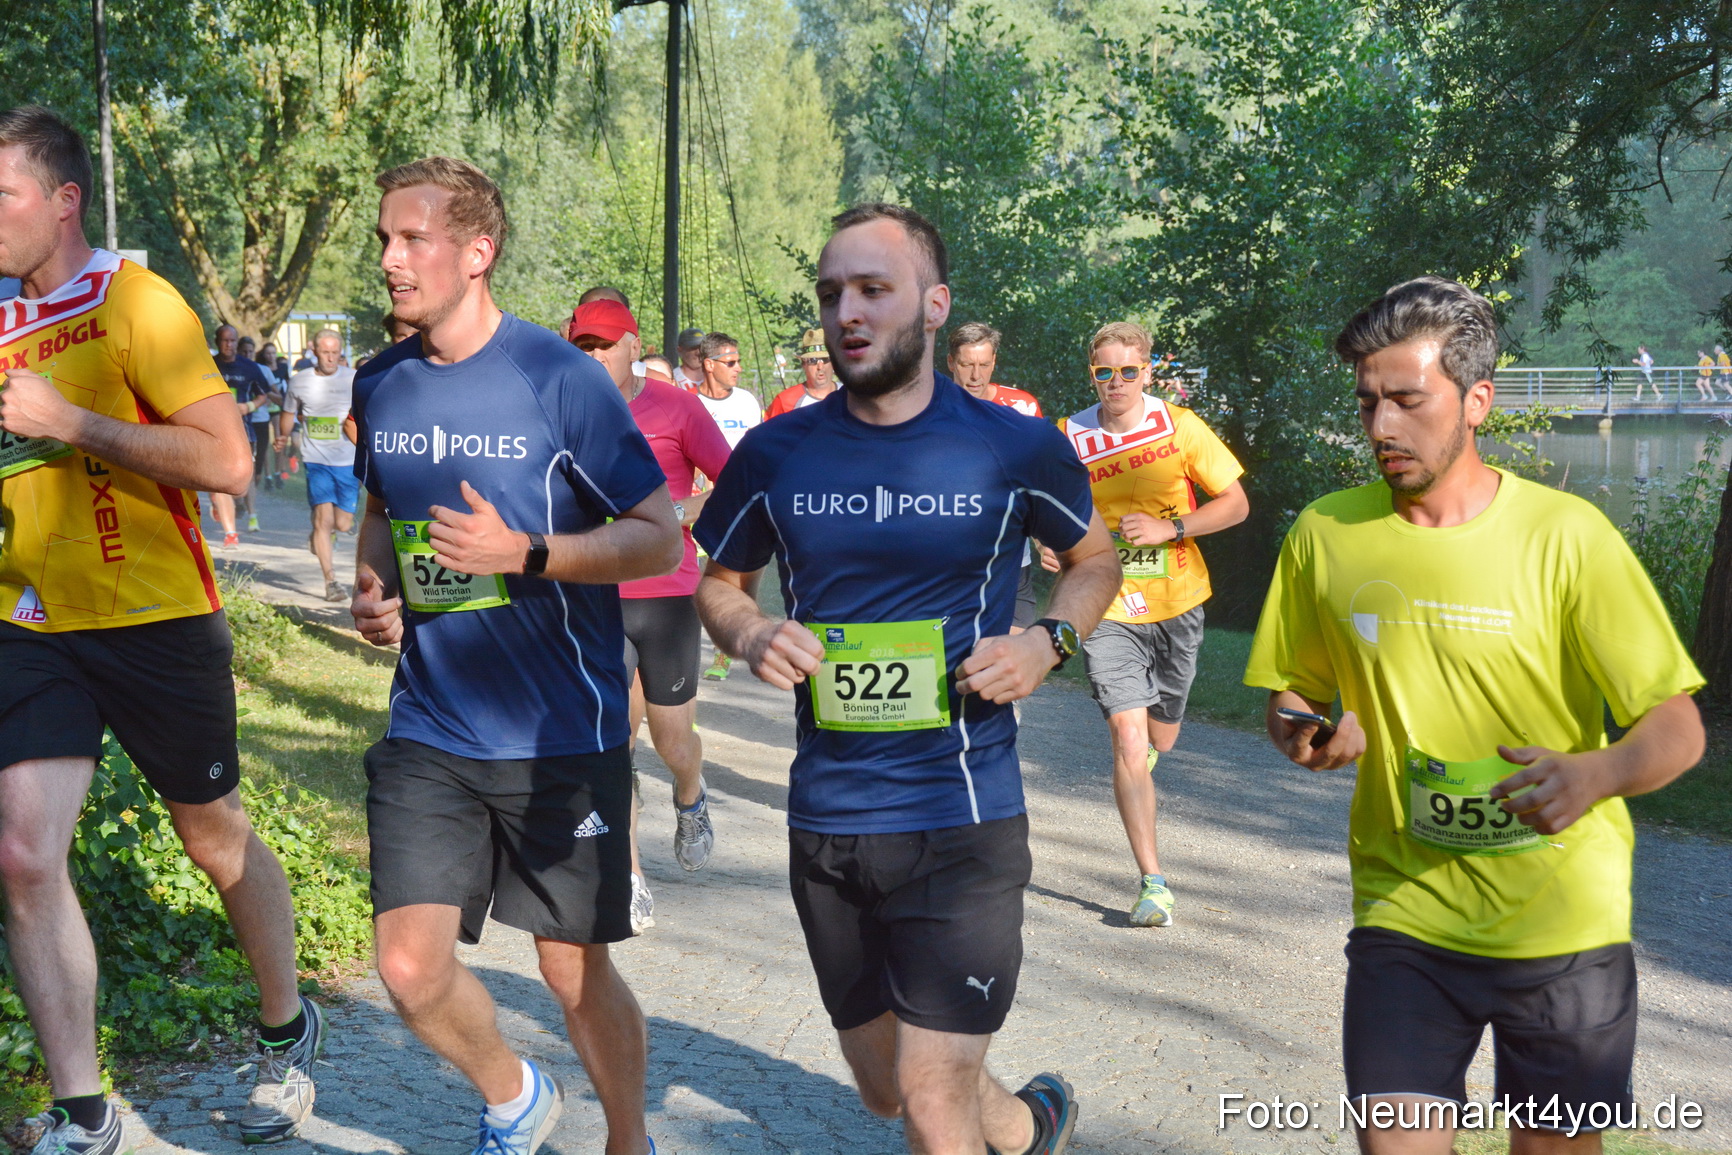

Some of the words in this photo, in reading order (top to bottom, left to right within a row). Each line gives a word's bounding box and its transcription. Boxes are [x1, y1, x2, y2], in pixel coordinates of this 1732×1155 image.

[38, 317, 108, 363] BÖGL
[311, 424, 335, 433] 2092
[14, 440, 48, 455] Christian
[451, 435, 527, 459] POLES
[1128, 441, 1180, 470] BÖGL
[793, 494, 868, 515] EURO
[899, 494, 983, 516] POLES
[422, 588, 439, 596] Wild
[442, 587, 471, 596] Florian
[1414, 599, 1448, 609] Kliniken
[822, 640, 863, 650] irmenlauf
[869, 648, 895, 658] 2018
[834, 662, 911, 700] 522
[843, 703, 879, 714] Böning
[882, 702, 906, 711] Paul
[845, 714, 879, 722] Europoles
[1430, 792, 1514, 830] 953
[574, 825, 609, 837] adidas
[1414, 818, 1488, 840] Ramanzanzda
[1492, 826, 1535, 840] Murtaza
